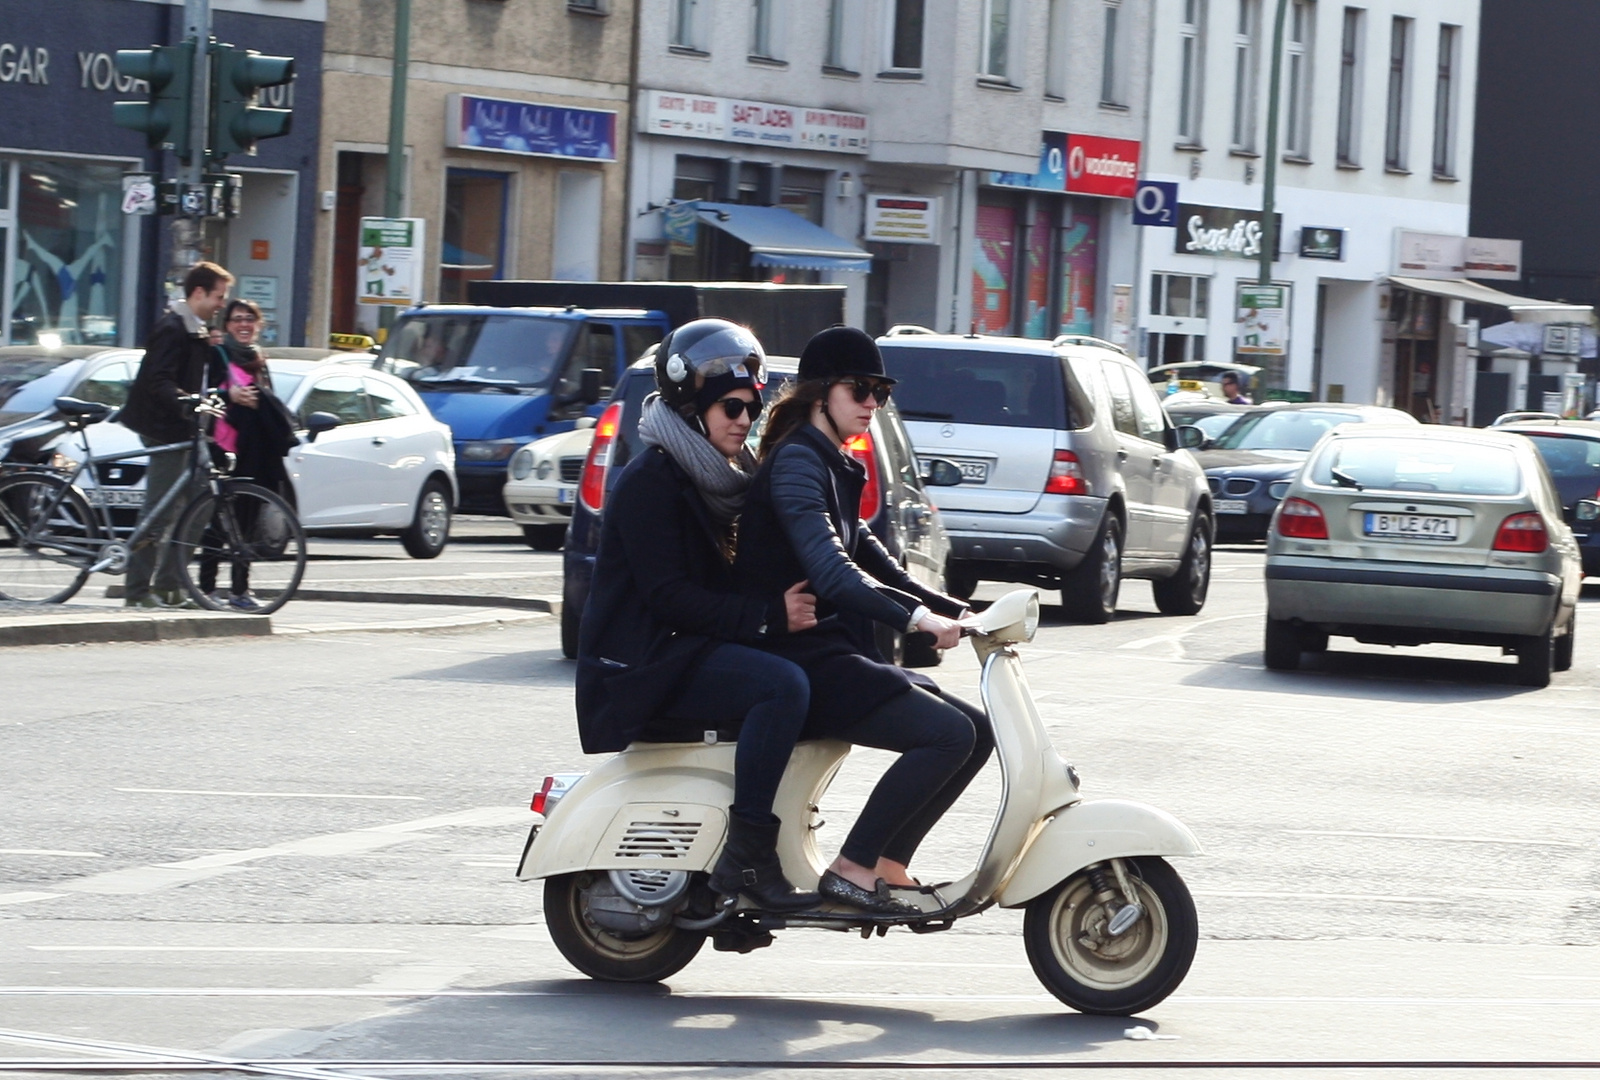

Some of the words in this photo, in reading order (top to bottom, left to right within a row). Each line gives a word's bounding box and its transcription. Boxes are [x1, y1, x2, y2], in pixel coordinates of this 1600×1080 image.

[732, 104, 795, 129] SAFTLADEN
[1085, 154, 1136, 179] vodafone
[1136, 186, 1171, 222] O2
[1422, 518, 1451, 534] 471
